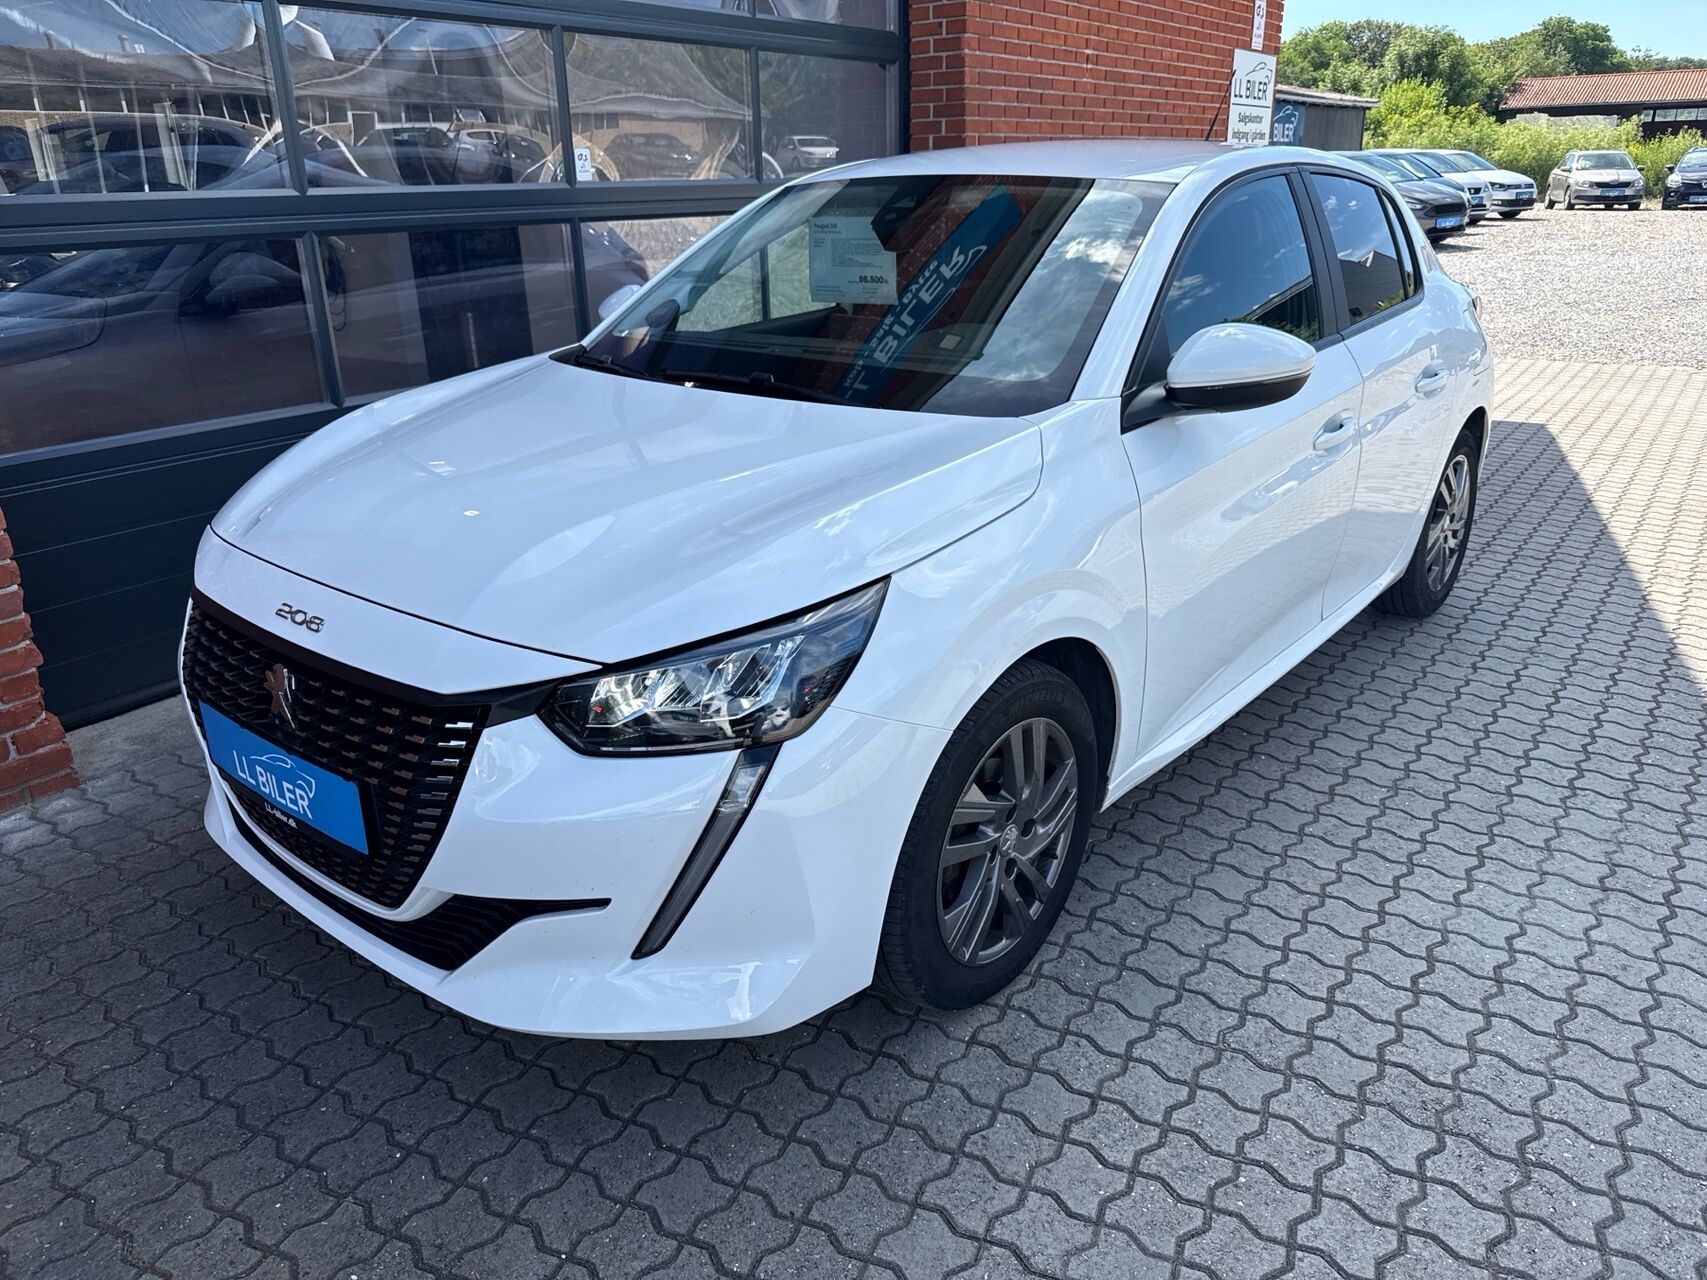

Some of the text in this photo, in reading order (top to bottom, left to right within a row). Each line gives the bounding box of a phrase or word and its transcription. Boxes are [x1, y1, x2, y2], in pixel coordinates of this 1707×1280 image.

[1234, 78, 1268, 101] LL BILER
[1238, 112, 1264, 126] Salgskontor
[1273, 122, 1294, 142] BILER
[275, 602, 325, 633] 208
[233, 750, 313, 820] LL BILER
